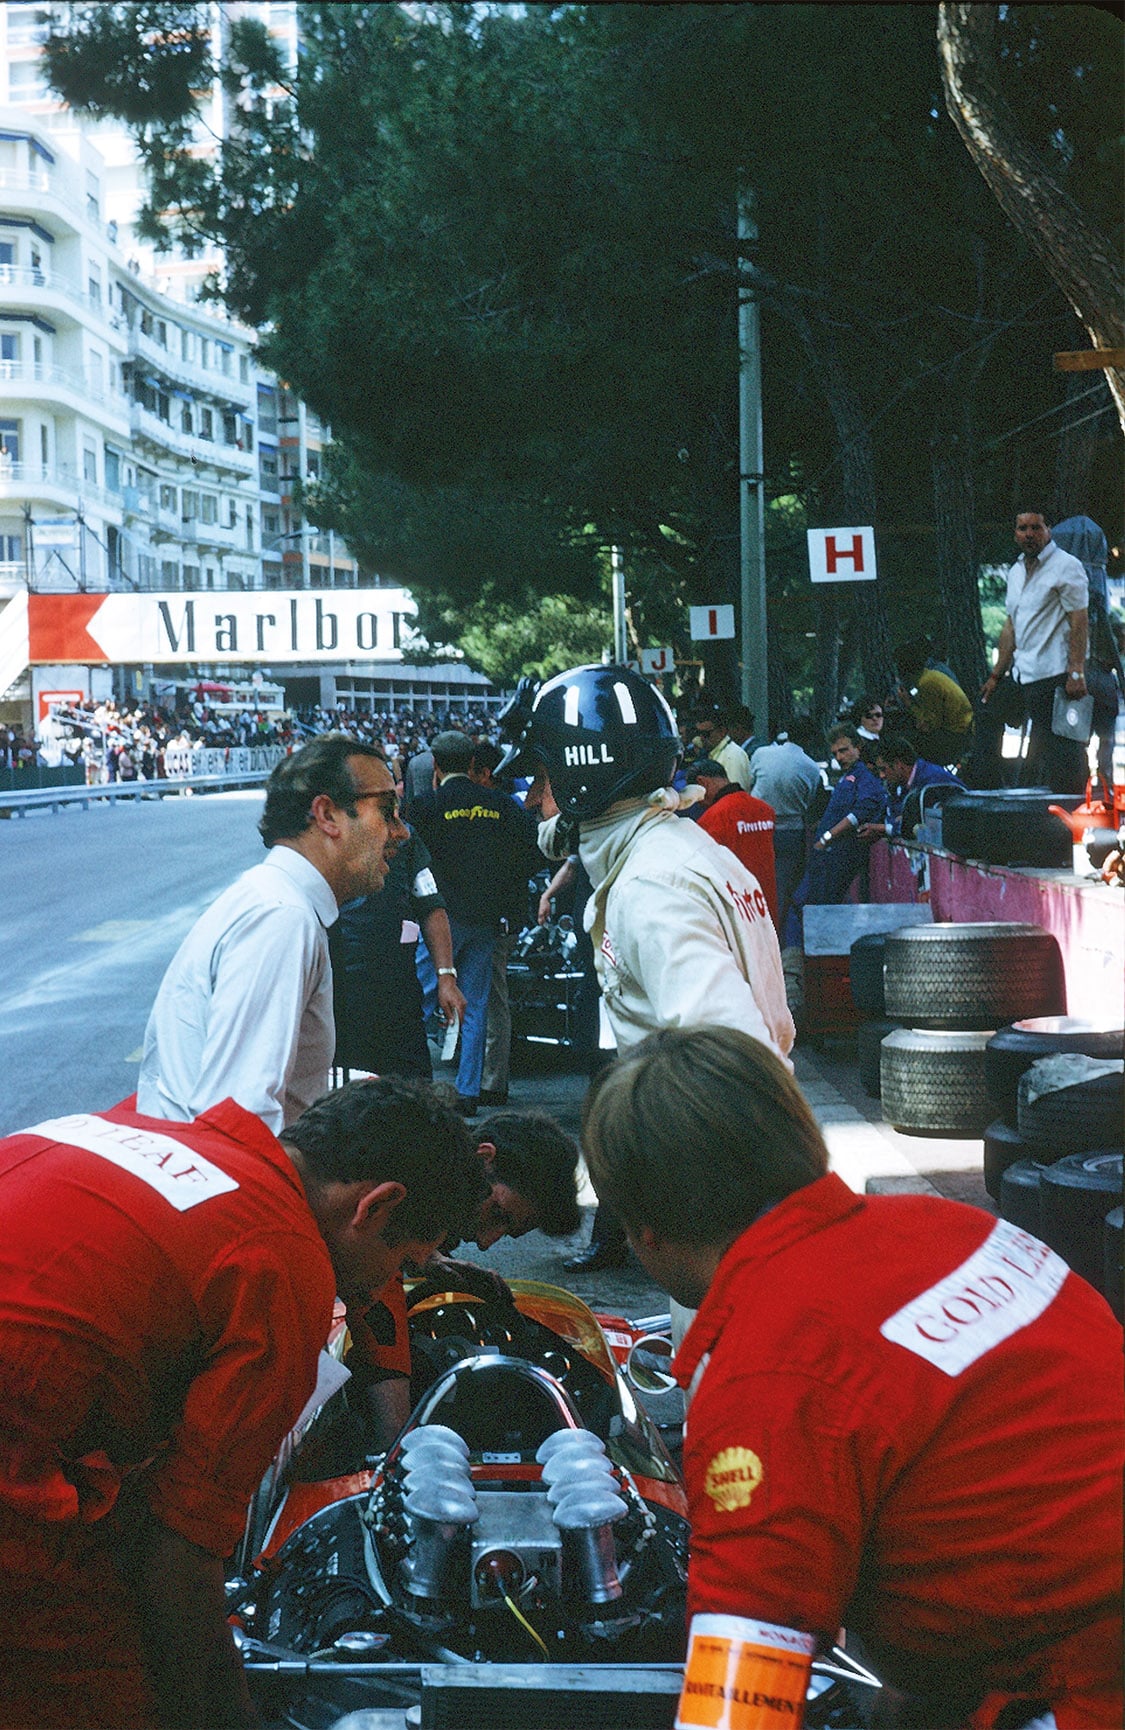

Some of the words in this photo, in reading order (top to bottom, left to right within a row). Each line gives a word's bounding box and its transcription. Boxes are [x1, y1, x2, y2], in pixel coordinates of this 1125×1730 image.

[825, 535, 864, 573] H
[709, 610, 718, 635] I
[652, 651, 666, 671] J
[564, 743, 614, 767] HILL
[444, 805, 500, 821] GOODYEAR
[915, 1274, 1017, 1343] GOLD
[711, 1465, 755, 1489] SHELL
